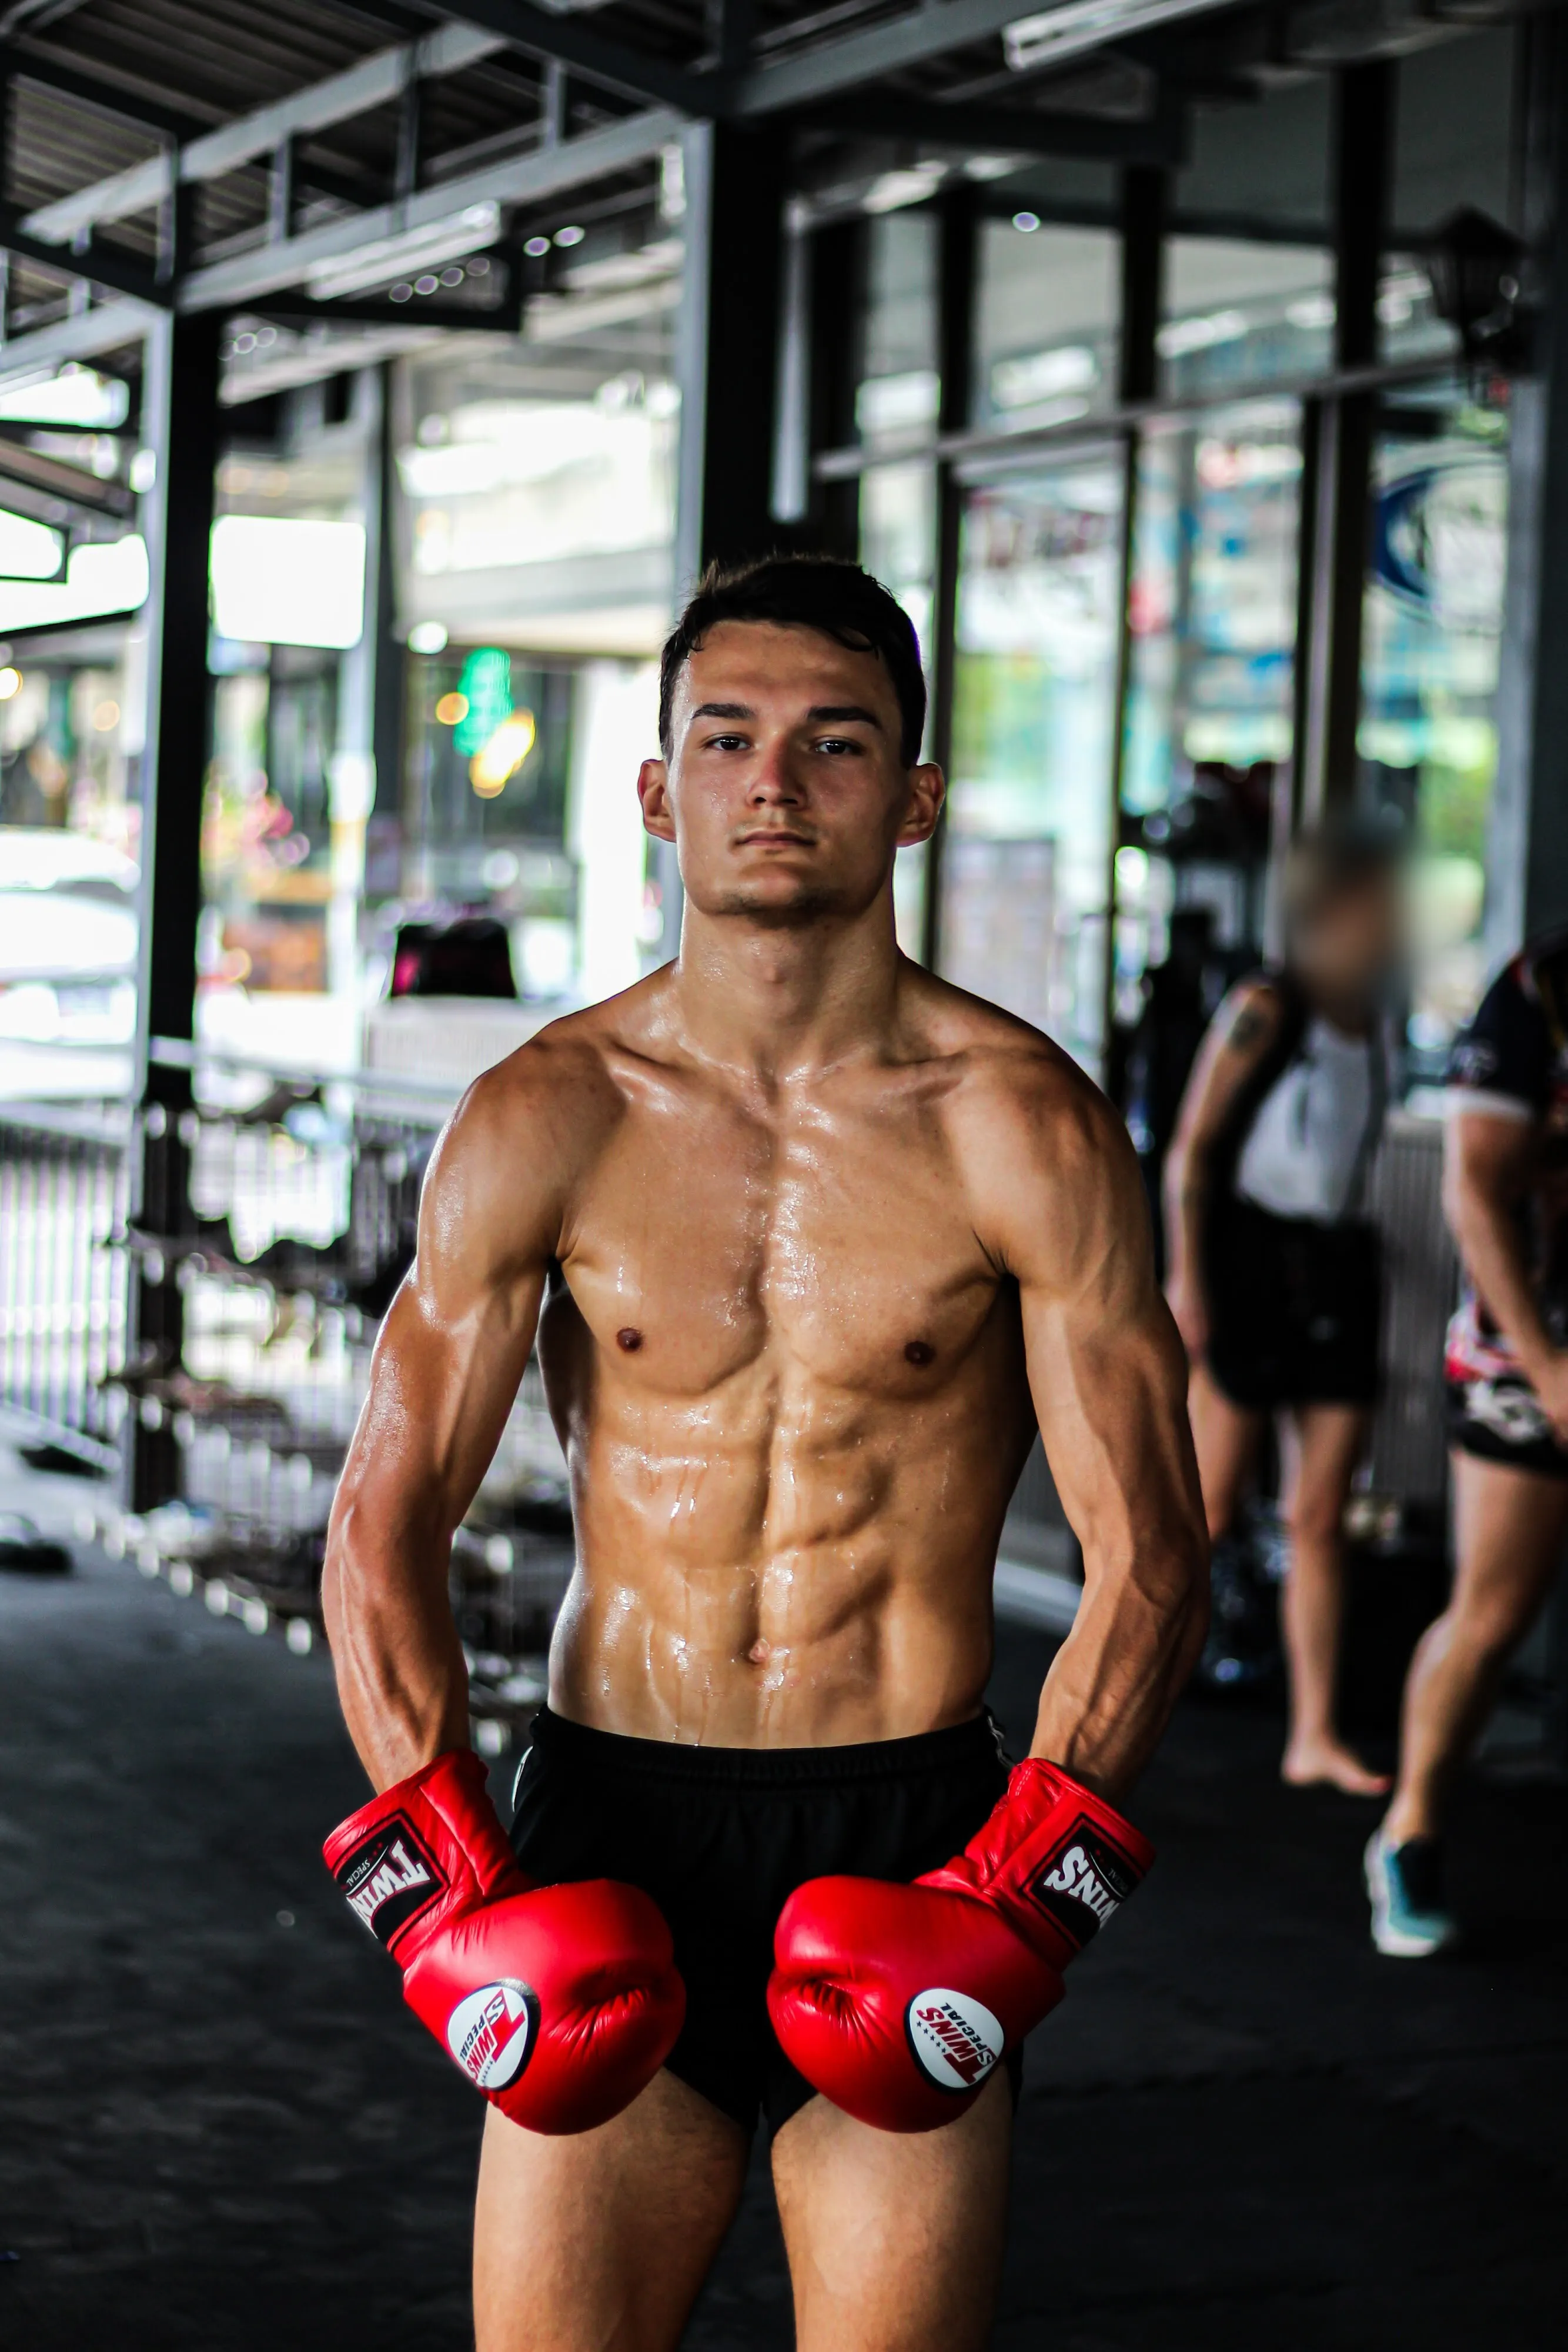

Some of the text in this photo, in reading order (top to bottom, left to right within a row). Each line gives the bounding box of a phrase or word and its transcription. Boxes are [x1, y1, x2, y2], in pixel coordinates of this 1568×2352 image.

[346, 1857, 370, 1887] SPECIAL
[346, 1840, 430, 1939] TWIN
[460, 1996, 506, 2062] SPECIAL
[466, 1988, 526, 2080] TWINS
[917, 2007, 998, 2085] TWINS
[941, 2002, 992, 2065] SPECIAL
